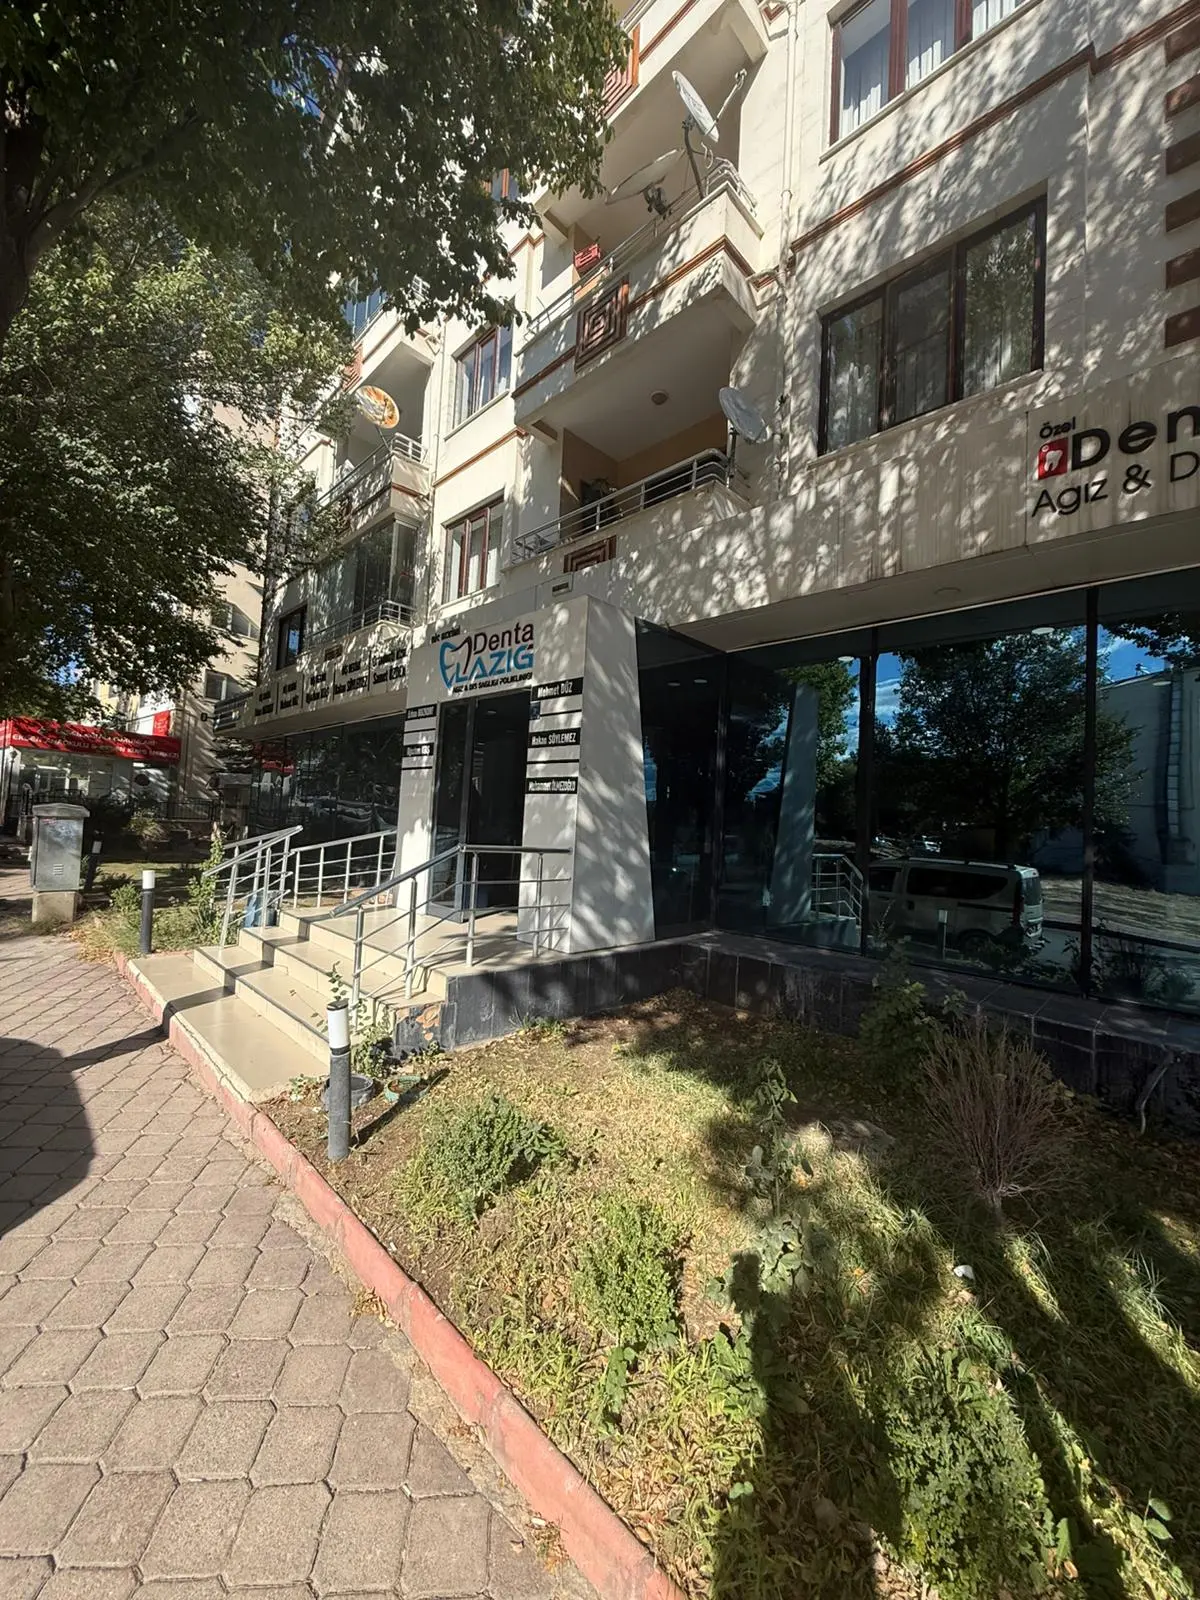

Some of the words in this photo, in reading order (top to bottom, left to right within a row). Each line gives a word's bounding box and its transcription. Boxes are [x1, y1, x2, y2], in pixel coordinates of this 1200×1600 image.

[1039, 416, 1076, 439] Özel
[1071, 405, 1200, 472] Den
[1122, 464, 1152, 495] &
[1169, 451, 1200, 483] D
[473, 621, 535, 654] Denta
